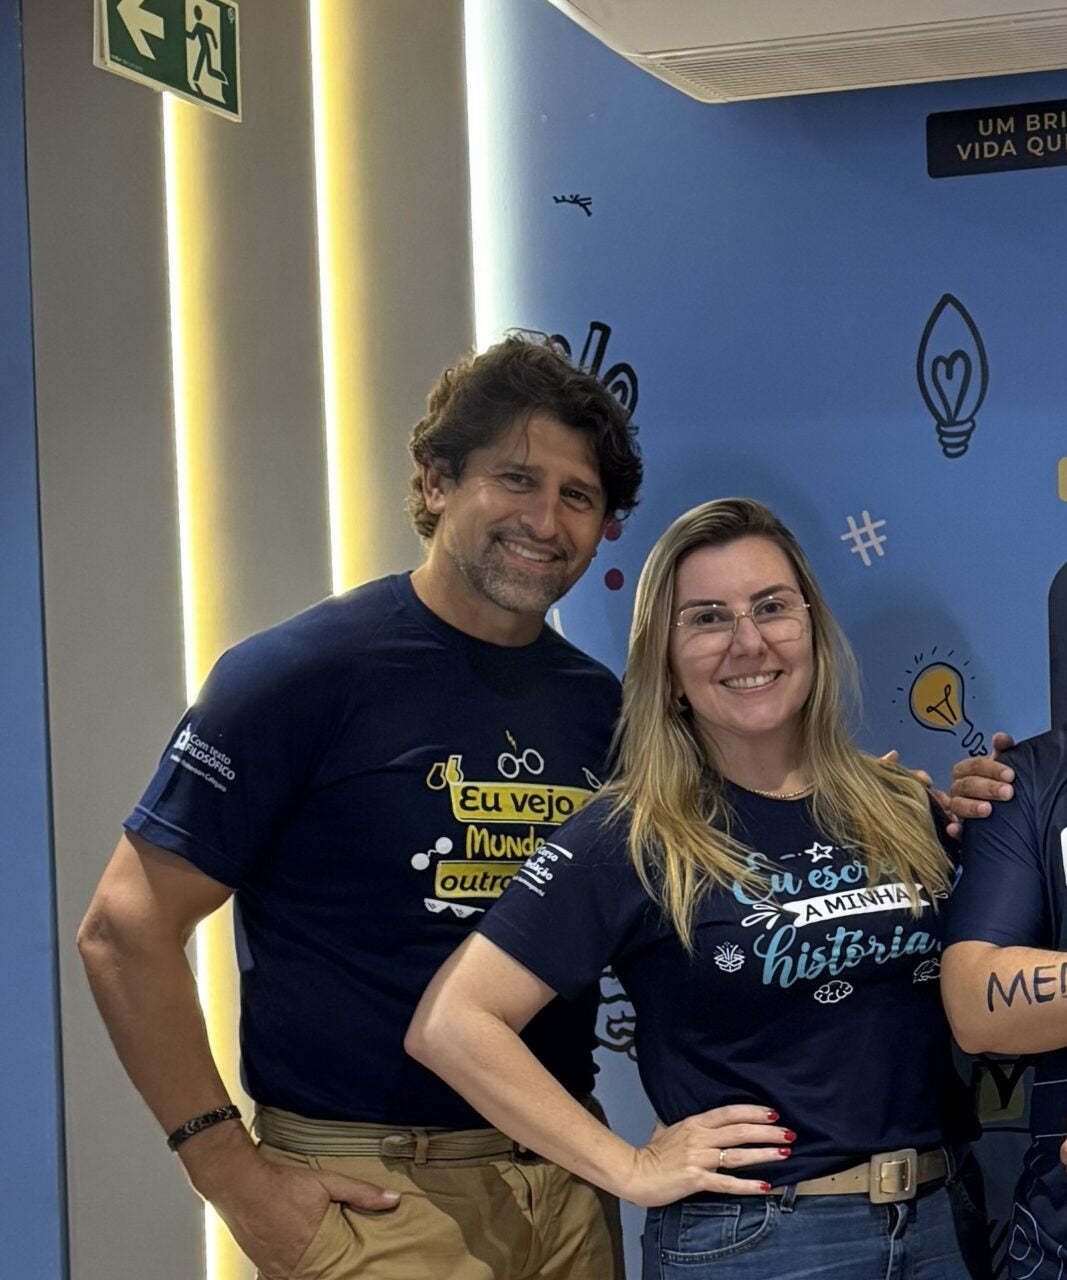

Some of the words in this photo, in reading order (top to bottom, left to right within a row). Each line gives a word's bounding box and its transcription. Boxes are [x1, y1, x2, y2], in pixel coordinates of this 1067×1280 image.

[978, 116, 1015, 136] UM
[957, 140, 1018, 161] VIDA
[190, 733, 209, 752] Com
[209, 745, 232, 766] texto
[459, 785, 502, 813] Eu
[511, 788, 574, 821] vejo
[805, 904, 823, 922] A
[824, 886, 912, 915] MINHA
